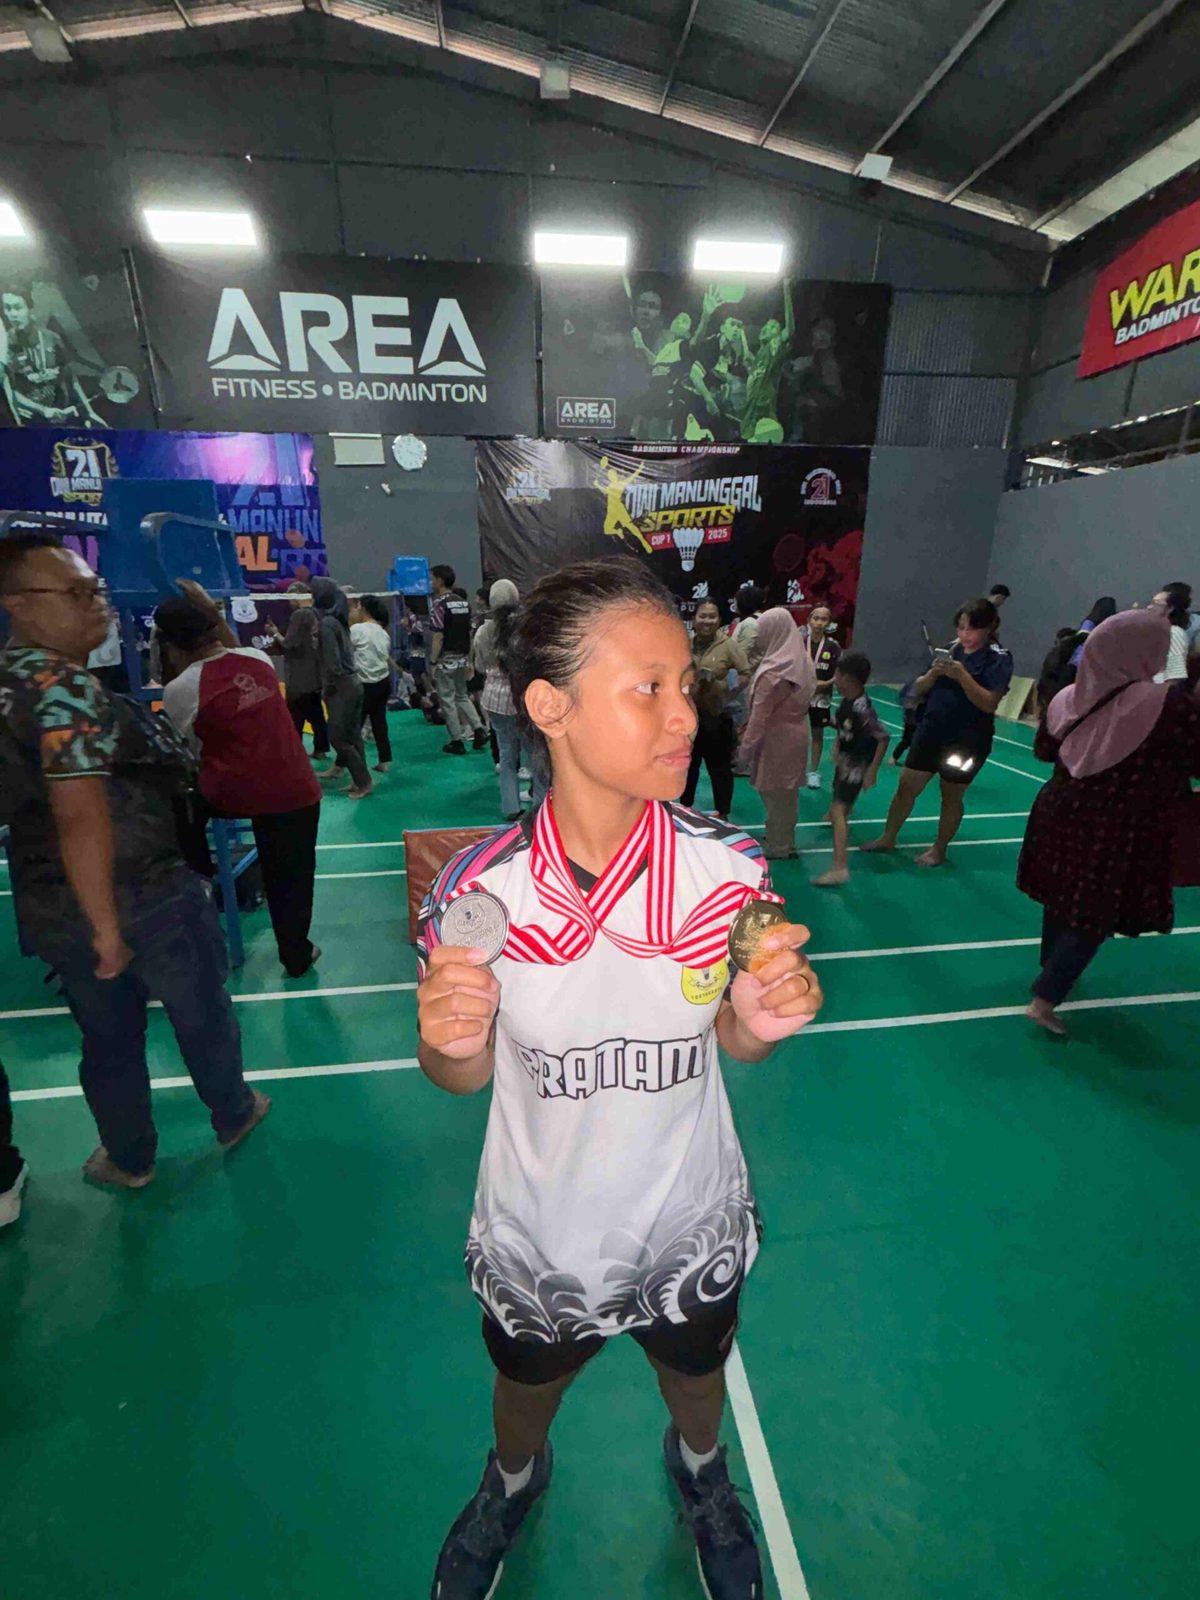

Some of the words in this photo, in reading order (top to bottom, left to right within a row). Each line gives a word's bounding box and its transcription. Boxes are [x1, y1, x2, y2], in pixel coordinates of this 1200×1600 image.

[207, 287, 487, 377] AREA
[211, 377, 318, 399] FITNESS
[338, 381, 487, 403] BADMINTON
[561, 402, 612, 418] AREA
[632, 445, 677, 453] BADMINTON
[681, 446, 741, 454] CHAMPIONSHIP
[660, 474, 762, 513] MANUNGGAL
[640, 504, 736, 533] SPORTS
[708, 528, 728, 540] 2025
[512, 1026, 712, 1100] PRATAM
